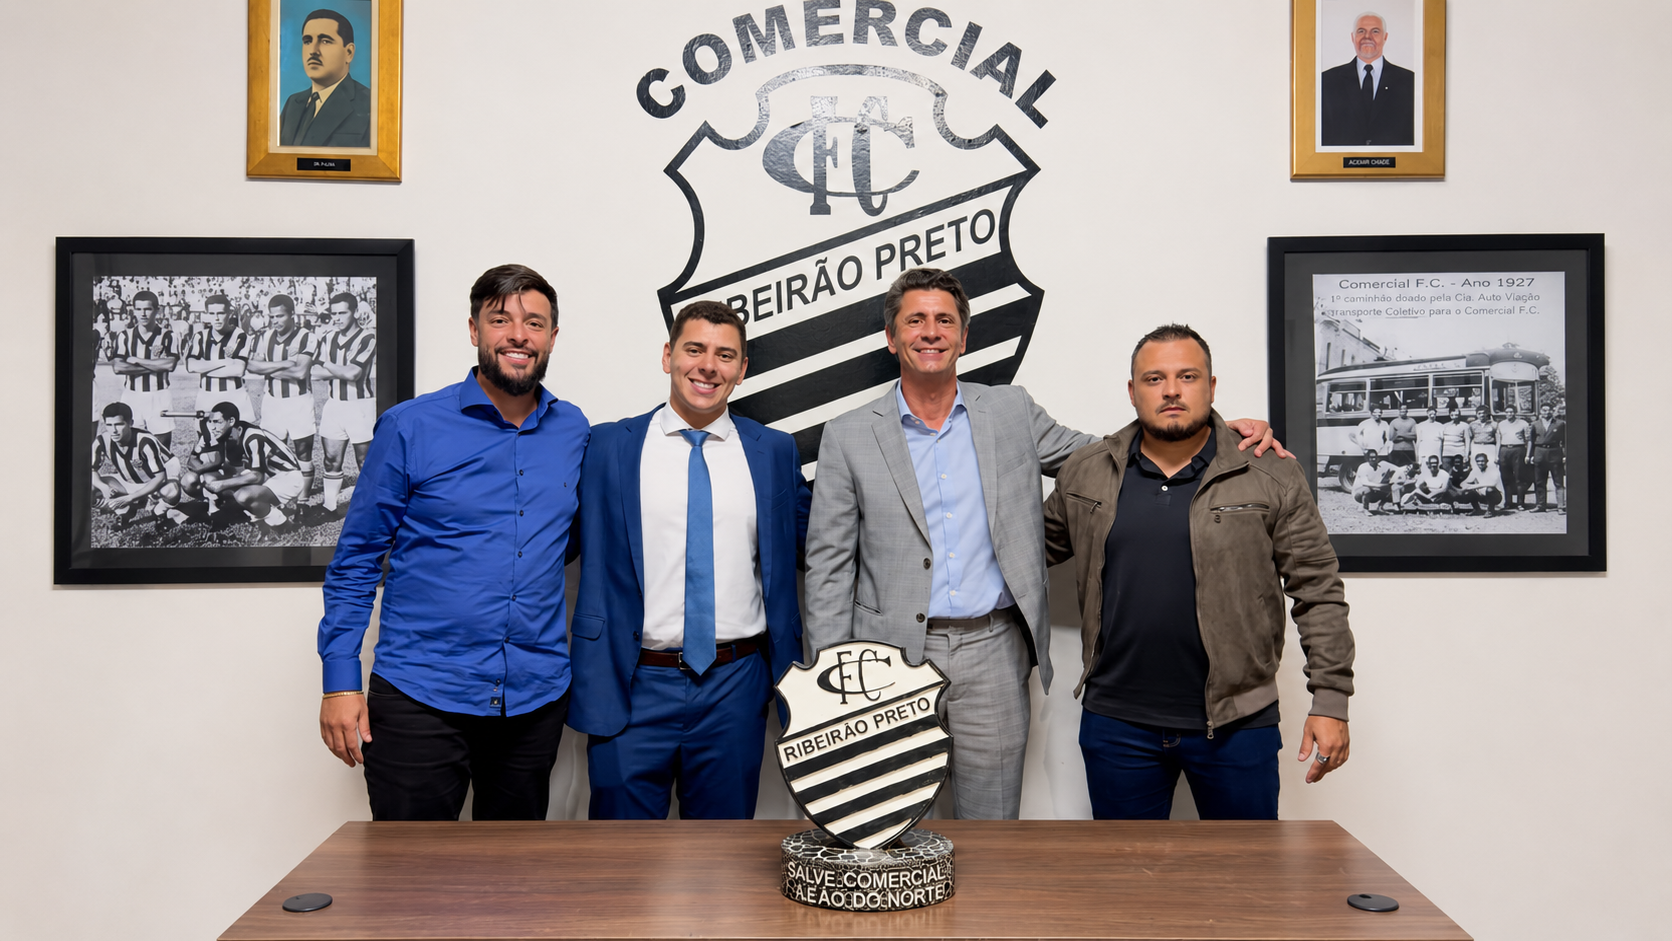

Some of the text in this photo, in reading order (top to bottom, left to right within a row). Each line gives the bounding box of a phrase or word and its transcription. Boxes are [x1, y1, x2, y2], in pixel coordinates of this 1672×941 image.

[636, 0, 1057, 129] COMERCIAL
[726, 208, 996, 324] BEIRÃO PRETO
[1338, 278, 1410, 290] Comercial
[1415, 277, 1445, 289] F.C.
[1460, 277, 1491, 288] Ano
[1496, 277, 1536, 288] 1927
[1343, 293, 1393, 303] caminhão
[1395, 293, 1427, 303] doado
[1429, 293, 1452, 304] pela
[1454, 292, 1475, 303] Cia.
[1477, 292, 1502, 302] Auto
[1504, 291, 1541, 304] Viação
[1385, 306, 1426, 317] Coletivo
[1428, 308, 1452, 318] para
[1464, 305, 1516, 316] Comercial
[1518, 305, 1541, 315] F.C.
[783, 697, 931, 762] RIBEIRÃO PRETO
[787, 861, 947, 889] SALVE COMERCIAL
[852, 891, 882, 909] DO
[887, 884, 945, 908] NORTE
